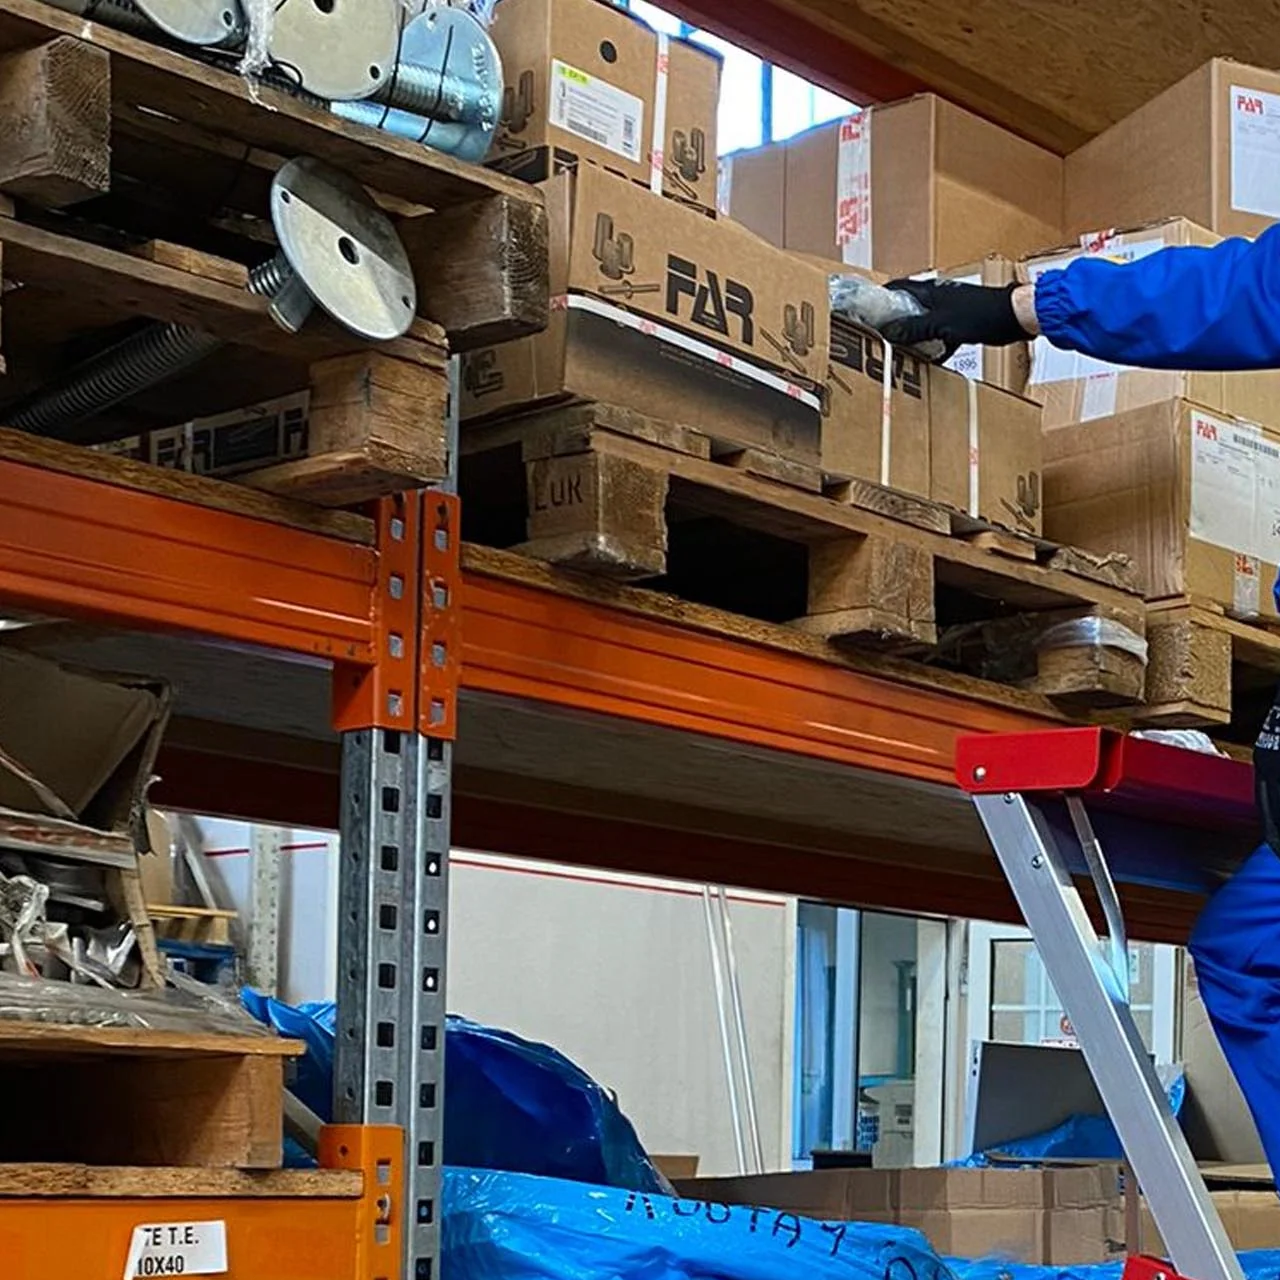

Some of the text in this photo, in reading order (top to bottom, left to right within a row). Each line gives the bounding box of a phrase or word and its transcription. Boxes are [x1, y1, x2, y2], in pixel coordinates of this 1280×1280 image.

[665, 253, 754, 347] FAR
[168, 1226, 199, 1246] T.E.
[137, 1255, 185, 1275] 10X40
